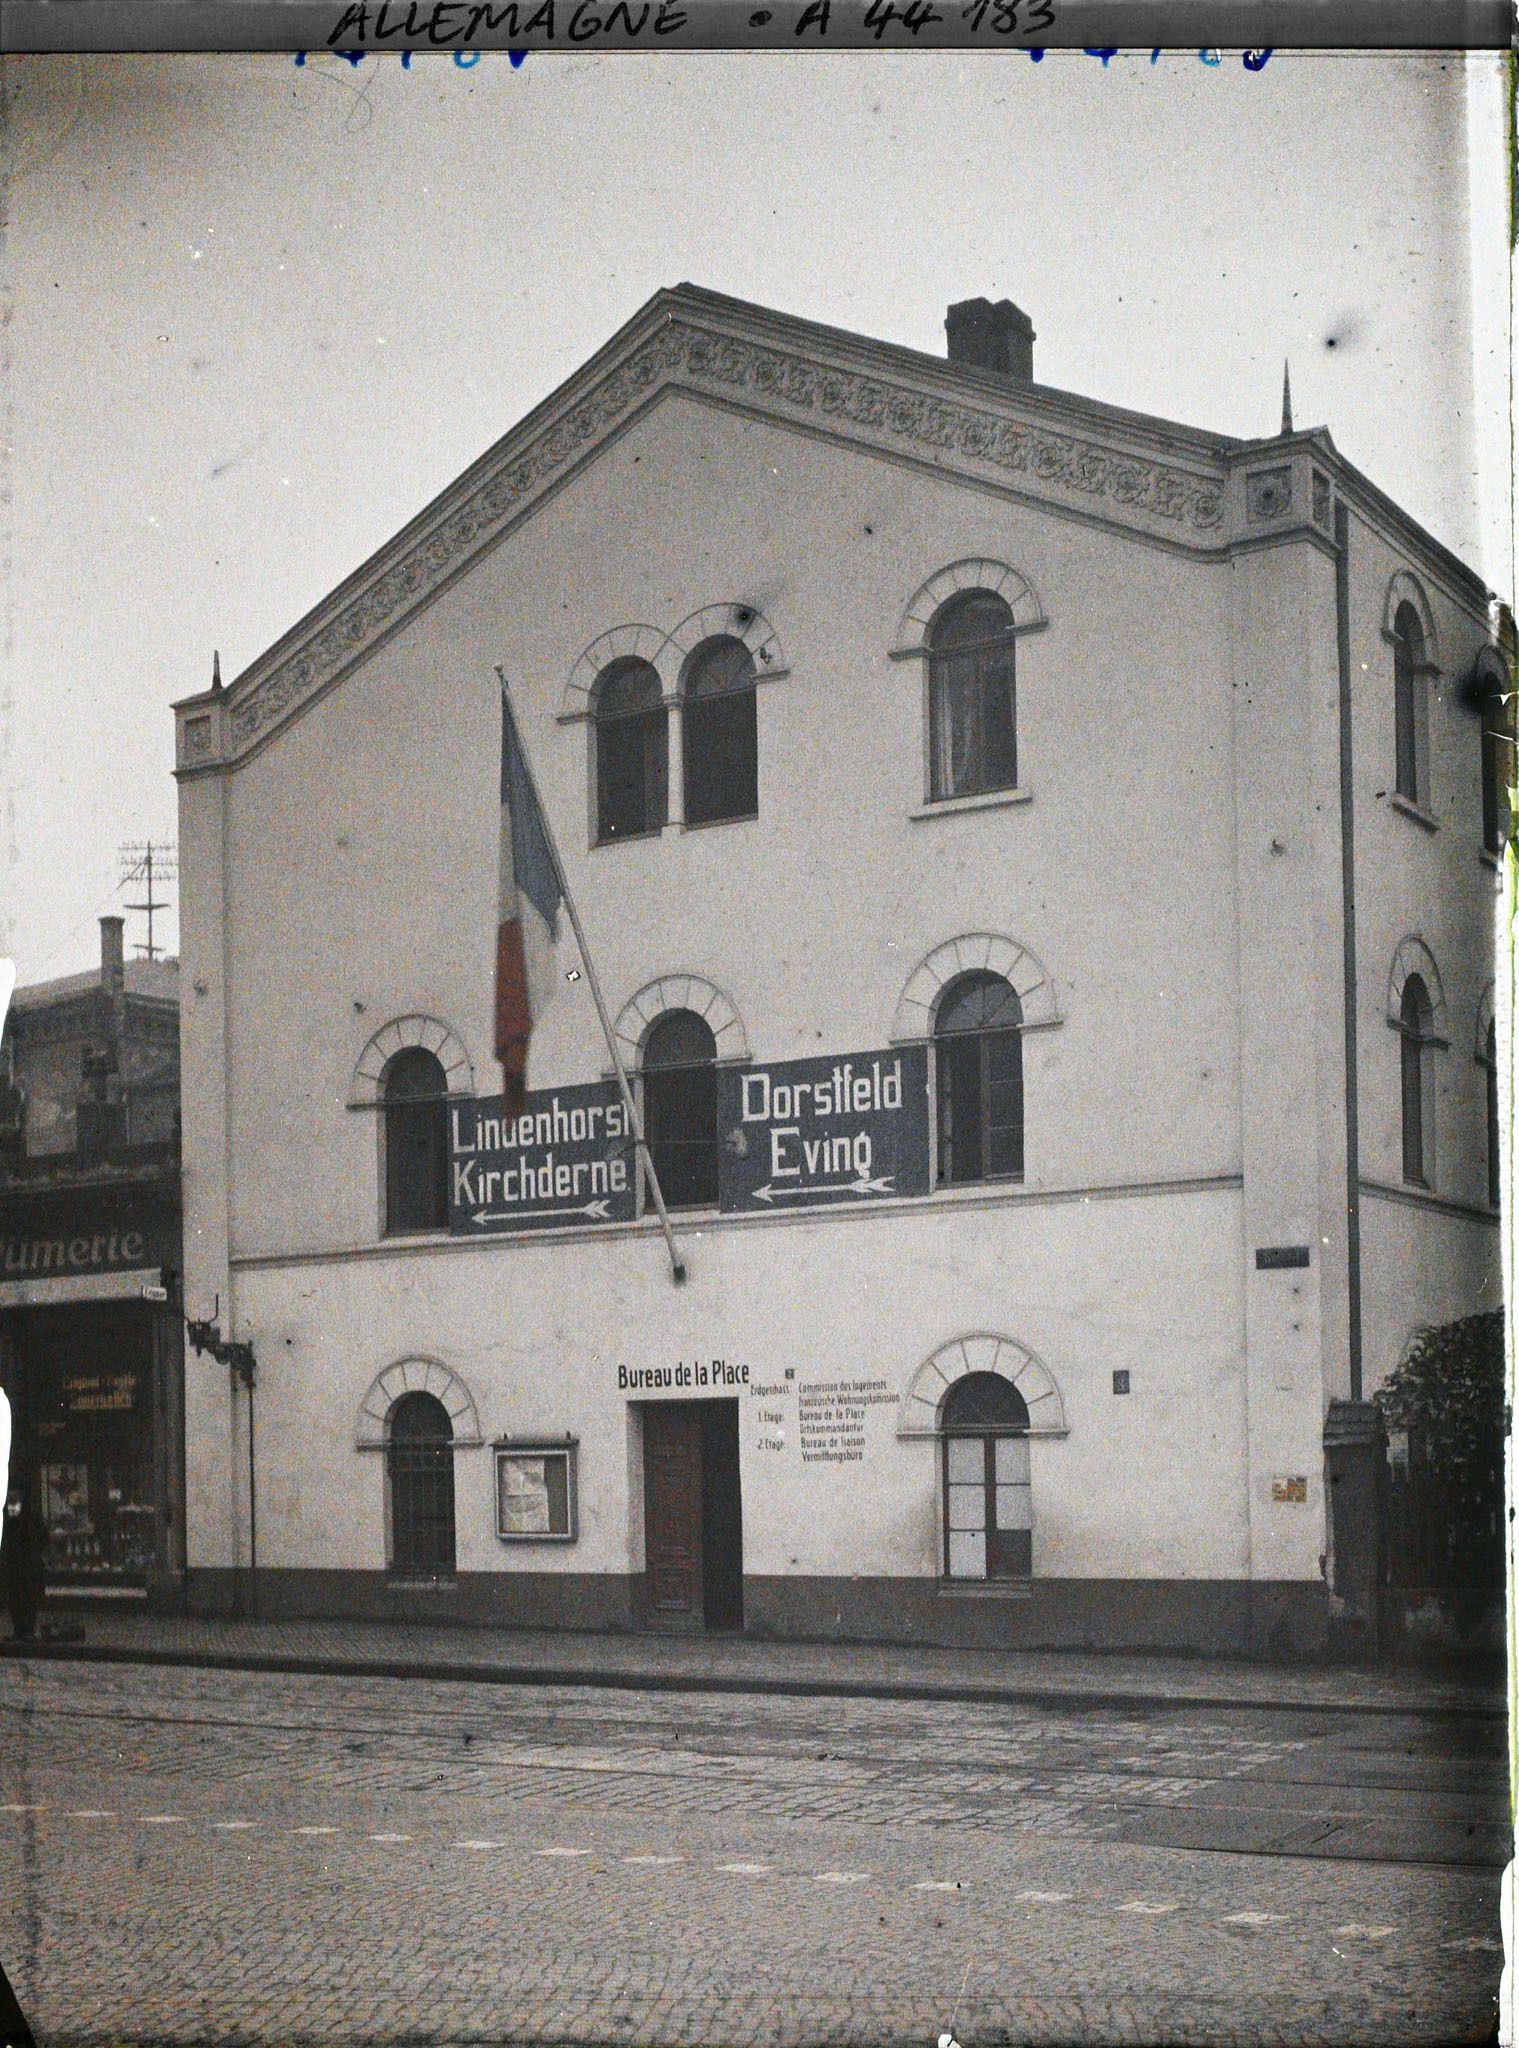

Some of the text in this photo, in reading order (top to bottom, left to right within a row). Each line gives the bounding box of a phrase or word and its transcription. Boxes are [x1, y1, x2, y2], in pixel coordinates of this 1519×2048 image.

[326, 0, 689, 45] ALLEMAGNE
[795, 0, 828, 36] A
[864, 0, 942, 39] 44
[741, 1059, 902, 1122] Dorstfeld
[770, 1126, 872, 1179] Eving
[618, 1360, 750, 1389] Bureau de la Place
[798, 1381, 838, 1393] Commission
[799, 1409, 823, 1422] Bureau
[824, 1408, 833, 1421] de
[845, 1407, 865, 1420] Place
[801, 1435, 866, 1449] Bureau de liaison
